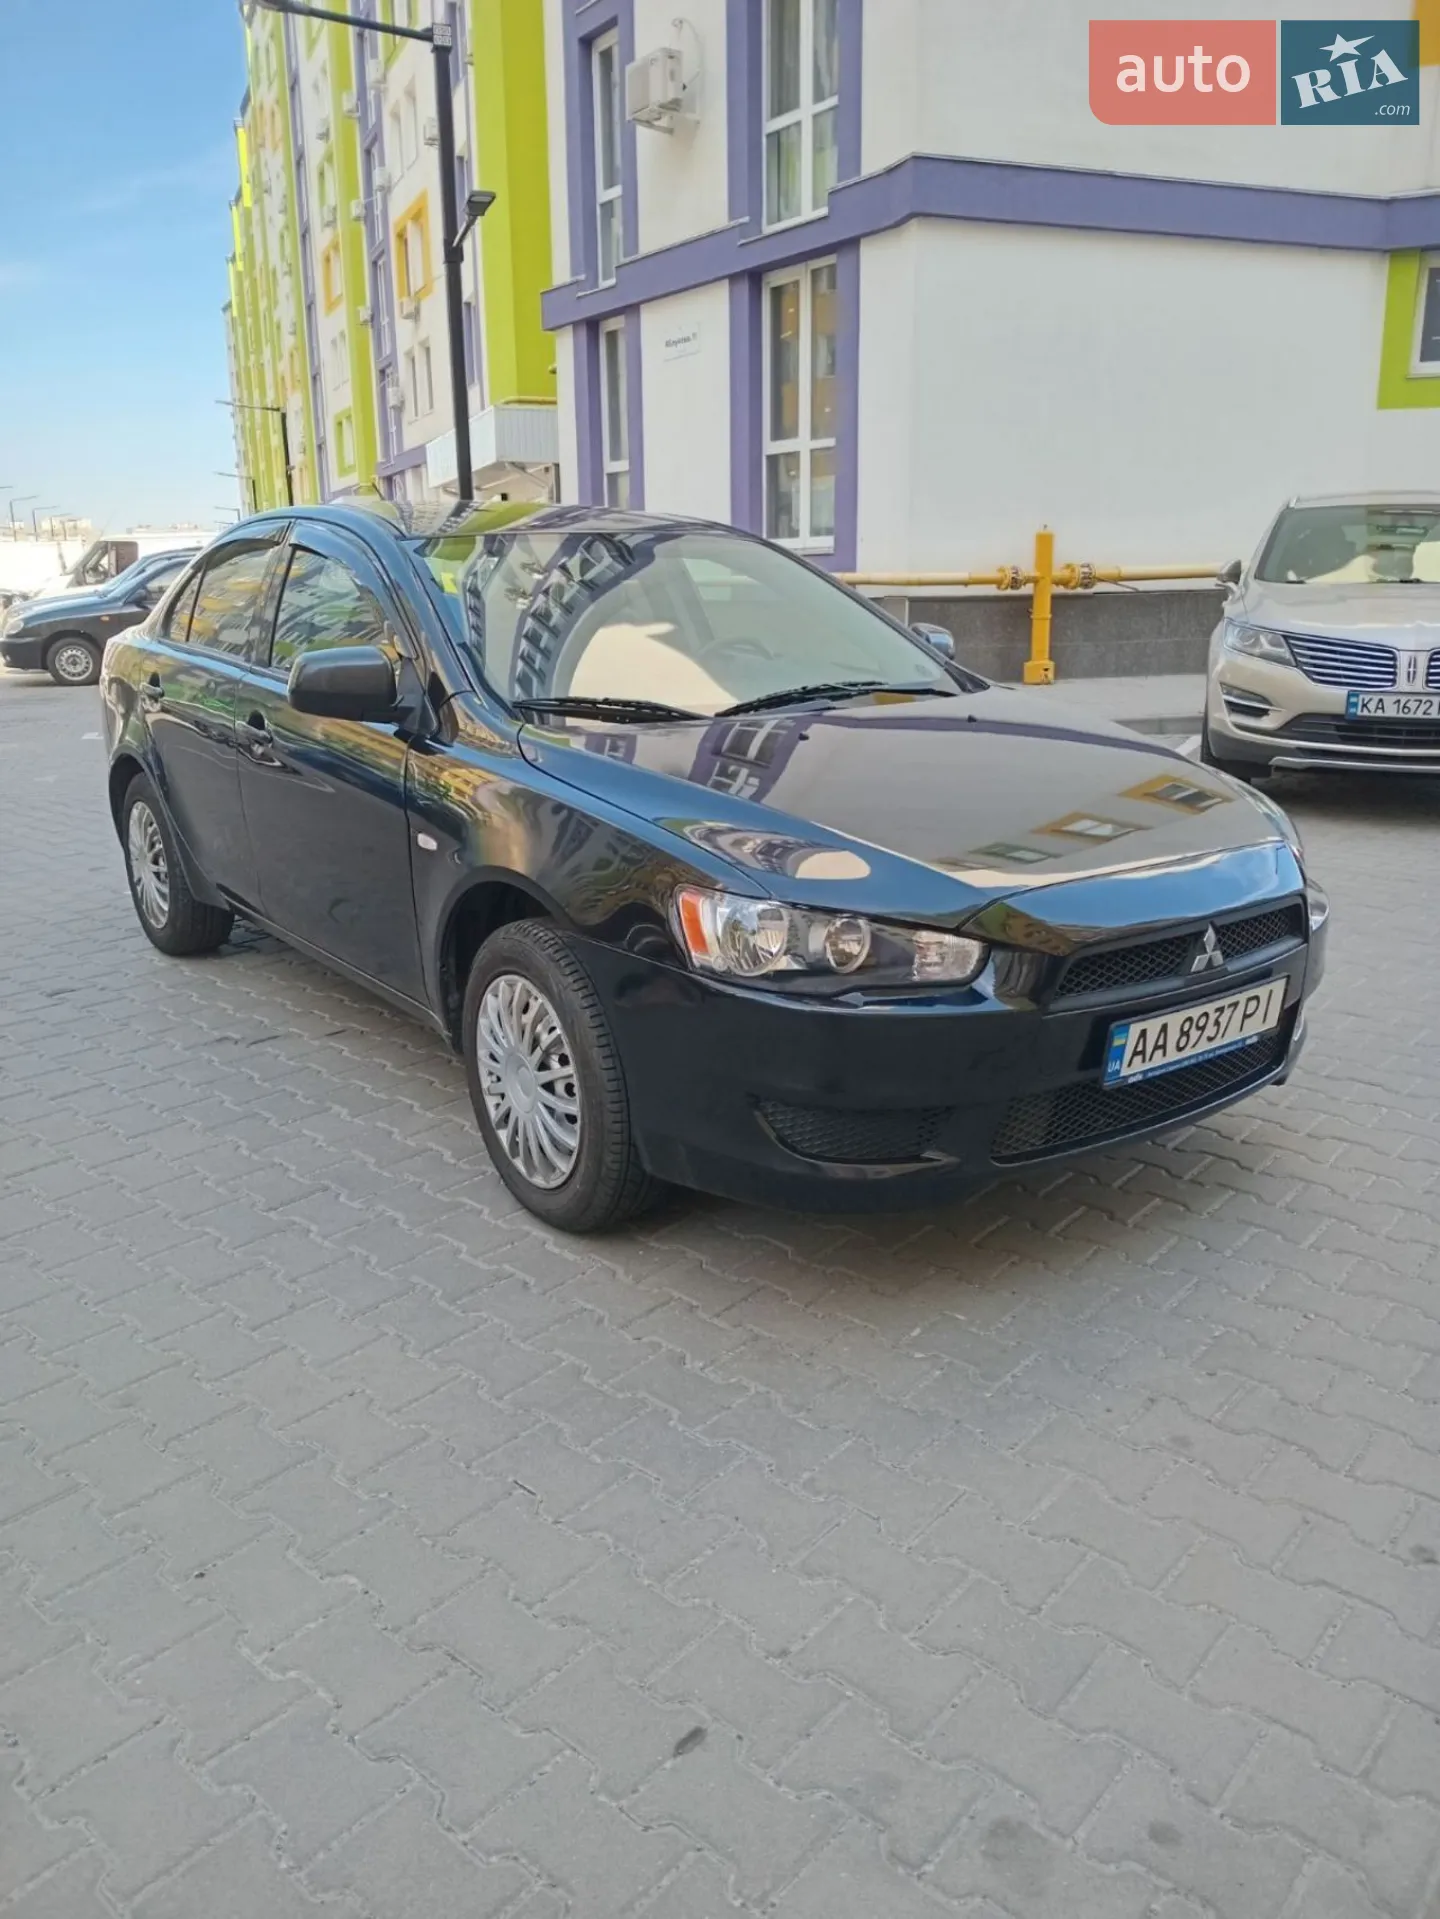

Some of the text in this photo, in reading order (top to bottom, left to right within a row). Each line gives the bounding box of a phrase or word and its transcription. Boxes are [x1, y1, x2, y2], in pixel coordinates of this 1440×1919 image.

[1360, 697, 1385, 714] KA
[1393, 699, 1433, 716] 1672
[1127, 1022, 1168, 1068] AA
[1175, 1001, 1240, 1052] 8937
[1239, 989, 1273, 1032] PI
[1107, 1060, 1121, 1074] UA
